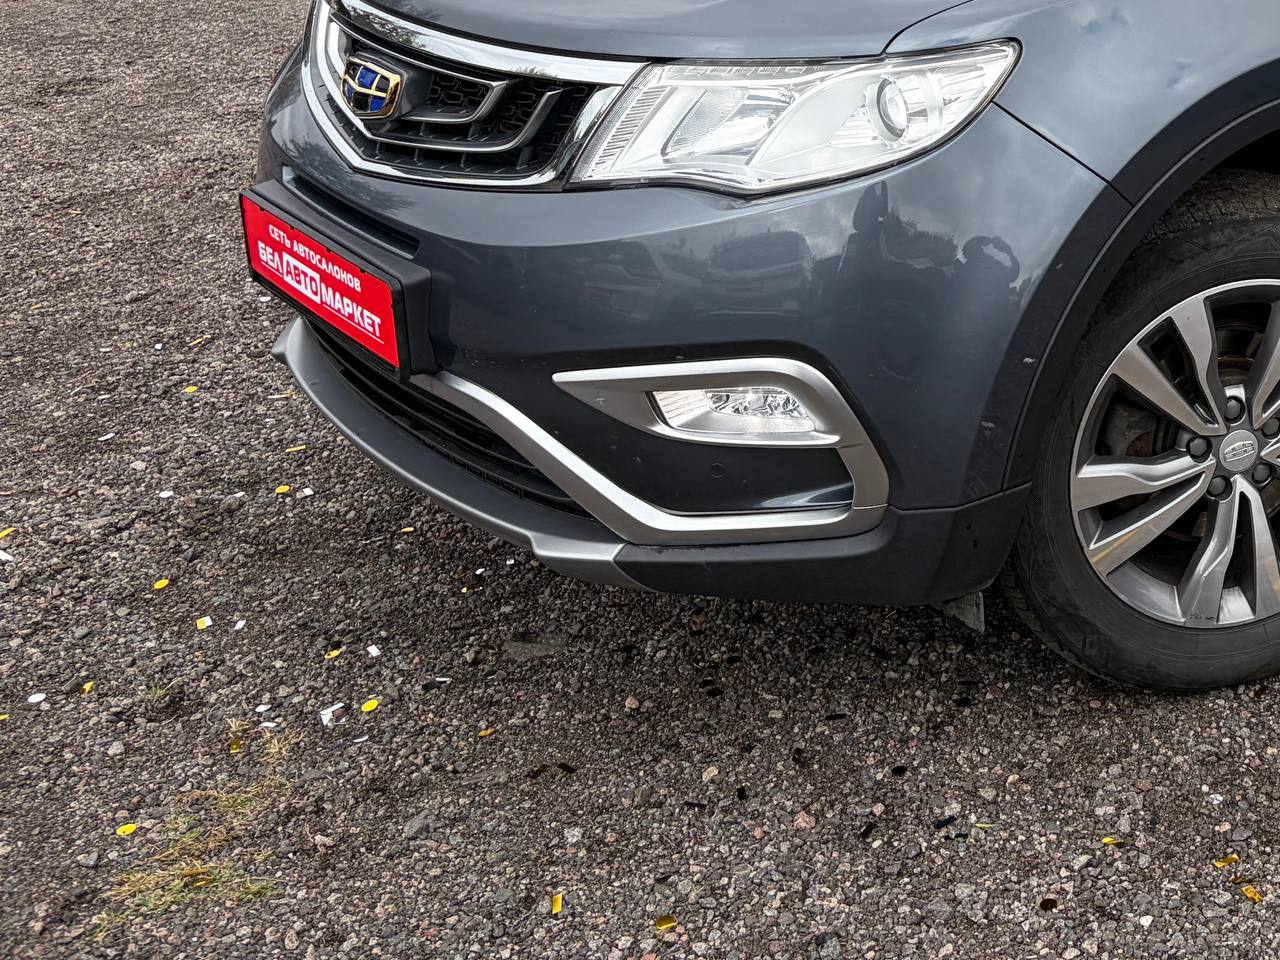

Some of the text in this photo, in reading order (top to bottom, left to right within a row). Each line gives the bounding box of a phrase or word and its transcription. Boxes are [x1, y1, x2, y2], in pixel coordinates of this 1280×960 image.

[257, 240, 382, 337] БЕЛ АВТО МАРКЕТ
[268, 224, 362, 293] СЕТЬ АВТОСАЛОНОВ
